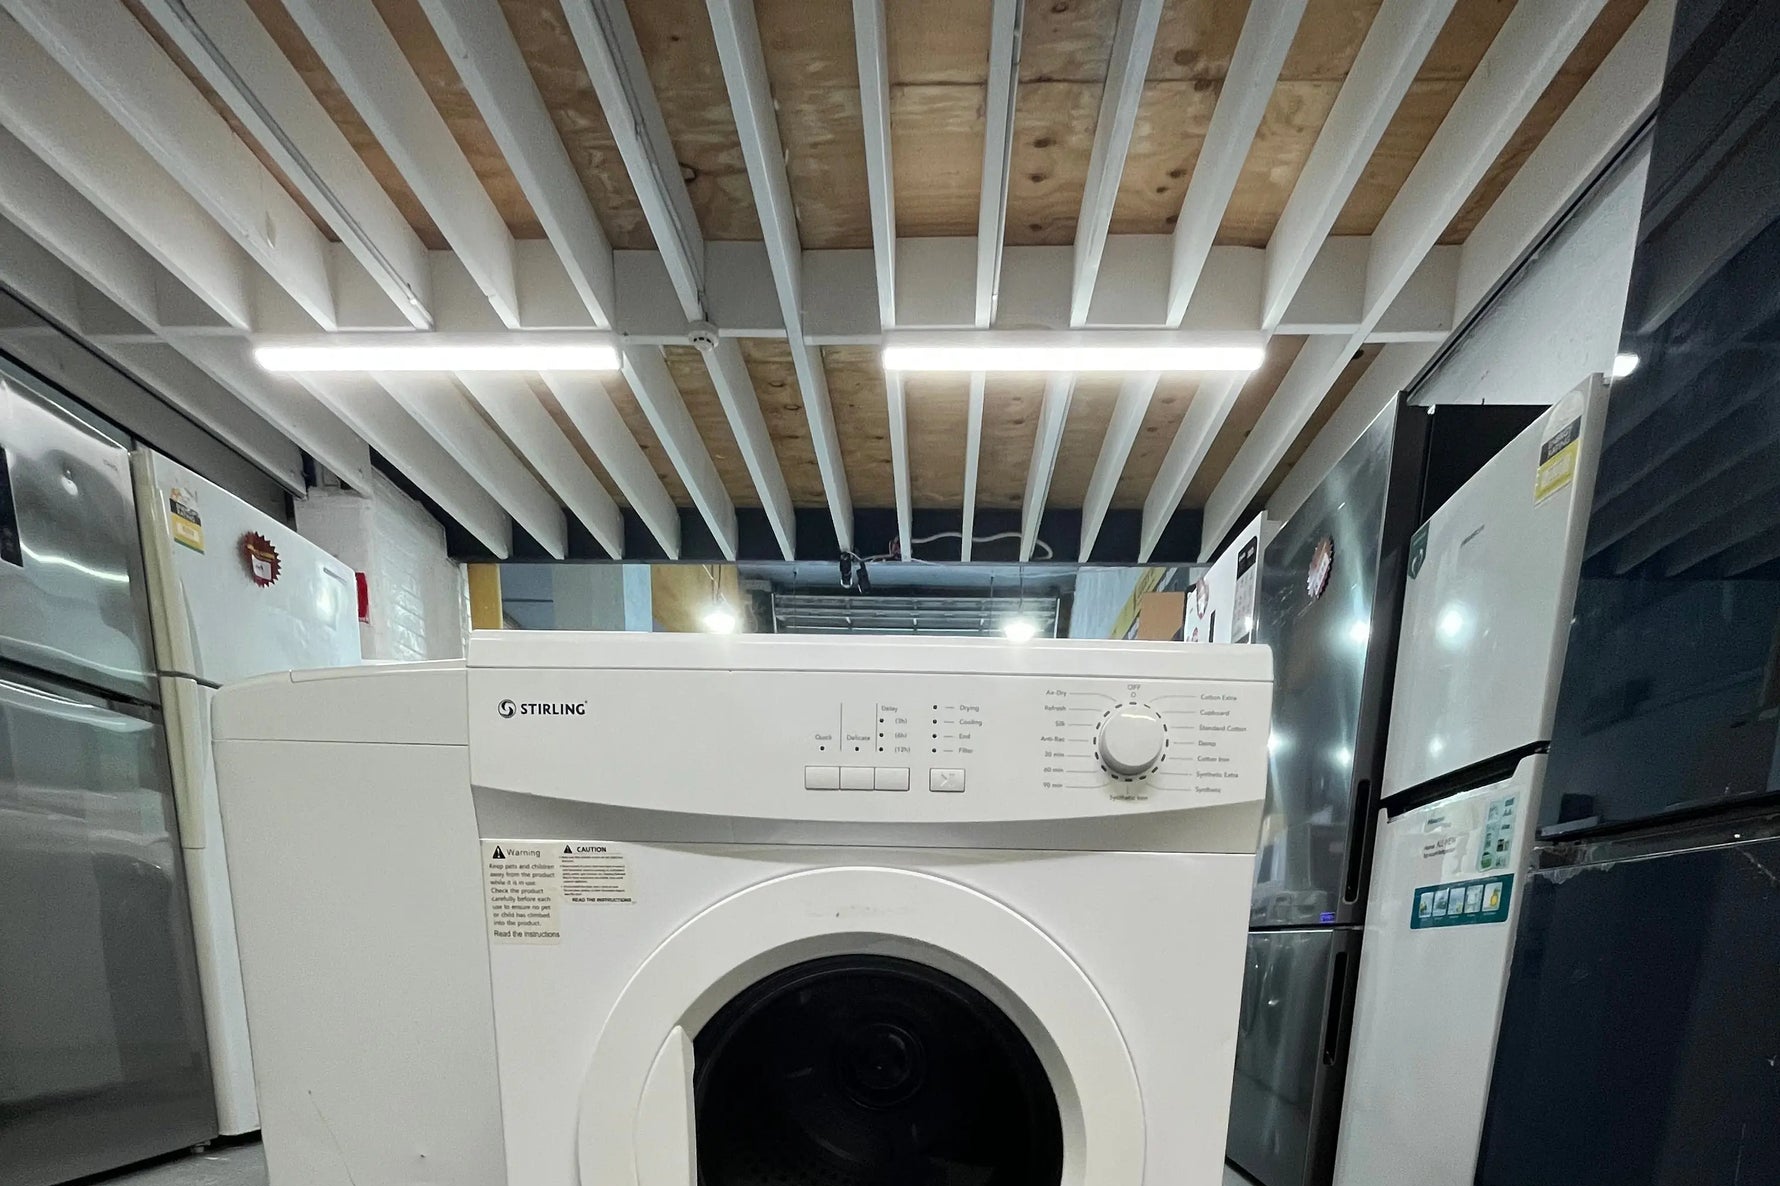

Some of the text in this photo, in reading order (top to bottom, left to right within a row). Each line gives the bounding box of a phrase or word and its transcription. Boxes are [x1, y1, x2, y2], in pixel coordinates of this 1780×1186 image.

[520, 703, 585, 715] STIRLING
[506, 848, 541, 857] Warning
[494, 930, 511, 938] Read
